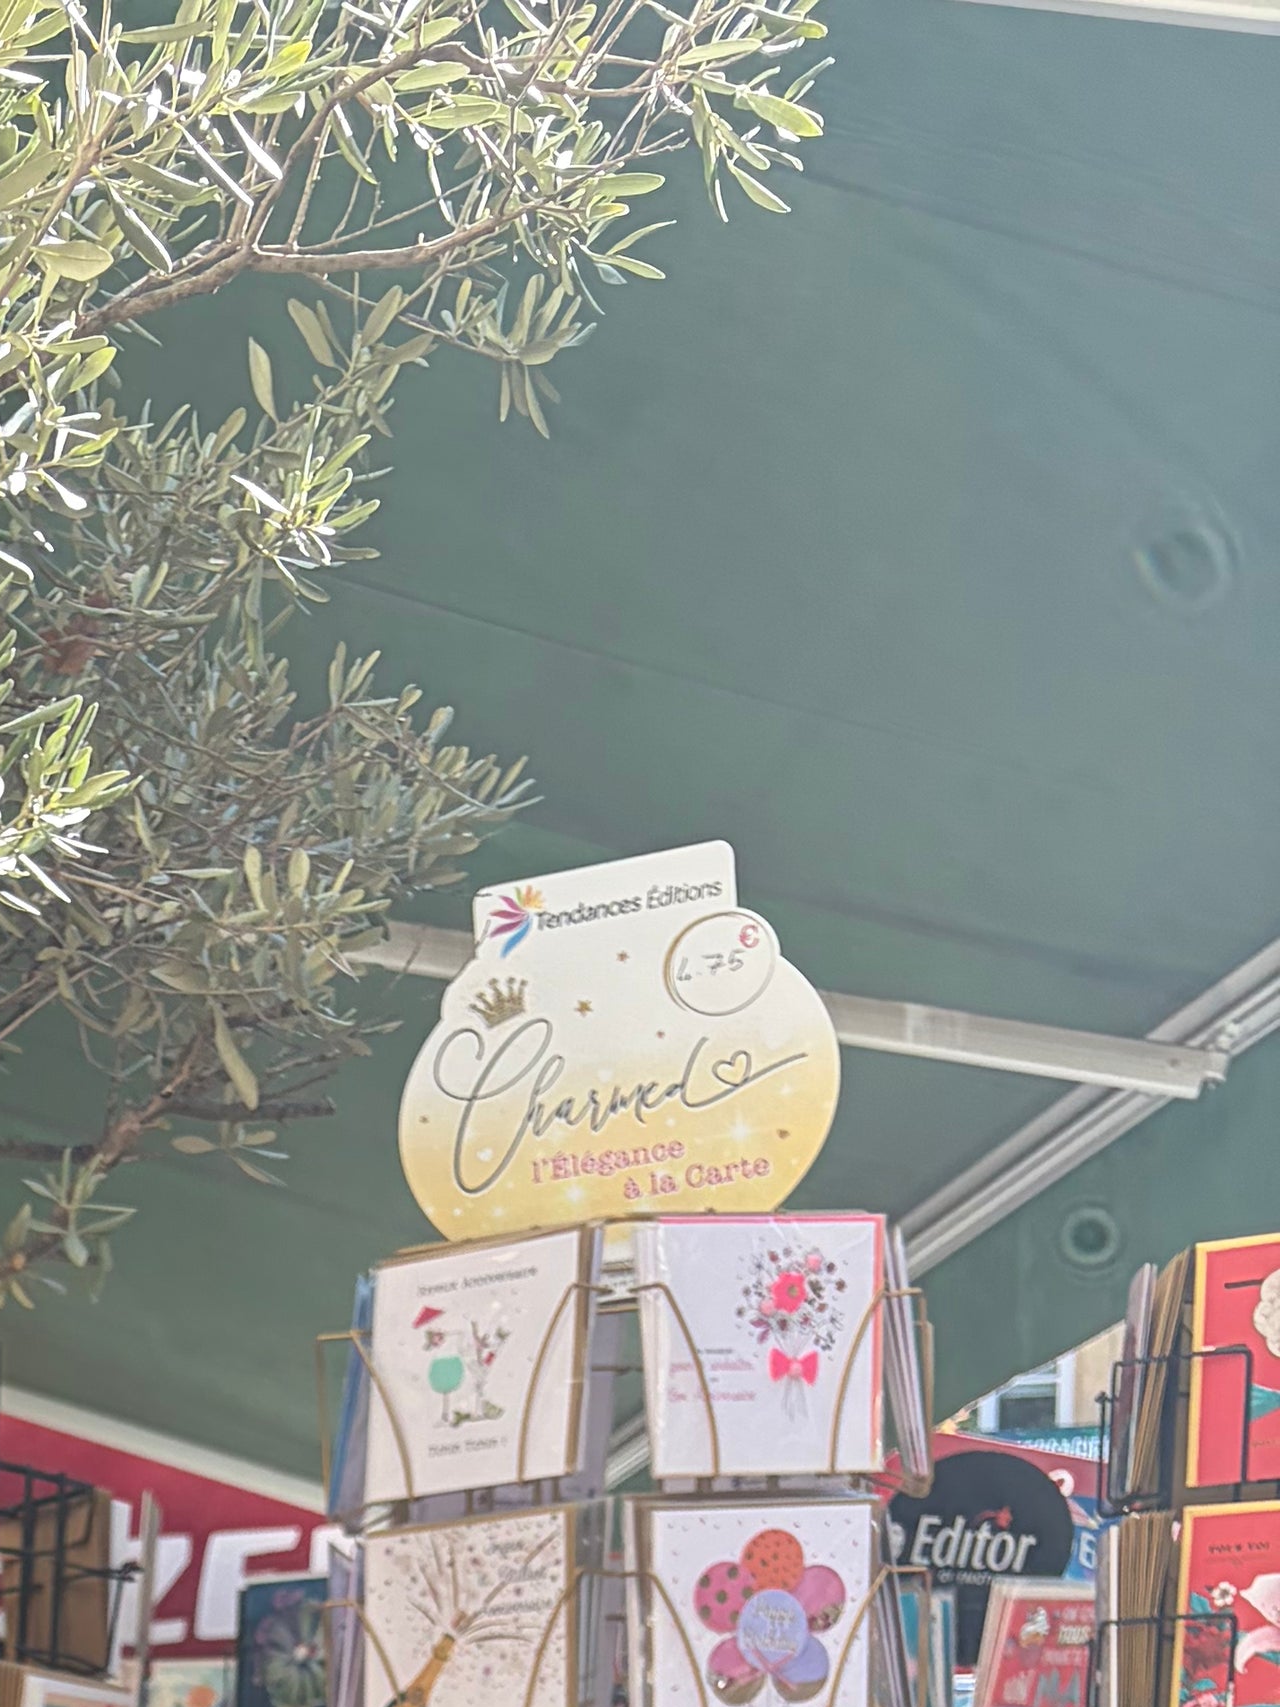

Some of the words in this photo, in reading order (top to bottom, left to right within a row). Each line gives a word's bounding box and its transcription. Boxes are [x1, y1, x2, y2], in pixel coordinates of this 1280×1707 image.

[536, 896, 641, 931] Tendances
[646, 881, 723, 910] Éditions
[433, 1018, 808, 1195] Charmed
[531, 1138, 685, 1184] l'Élégance
[623, 1175, 641, 1201] à
[650, 1171, 677, 1197] la
[685, 1155, 771, 1189] Carte
[910, 1514, 1037, 1573] Editor
